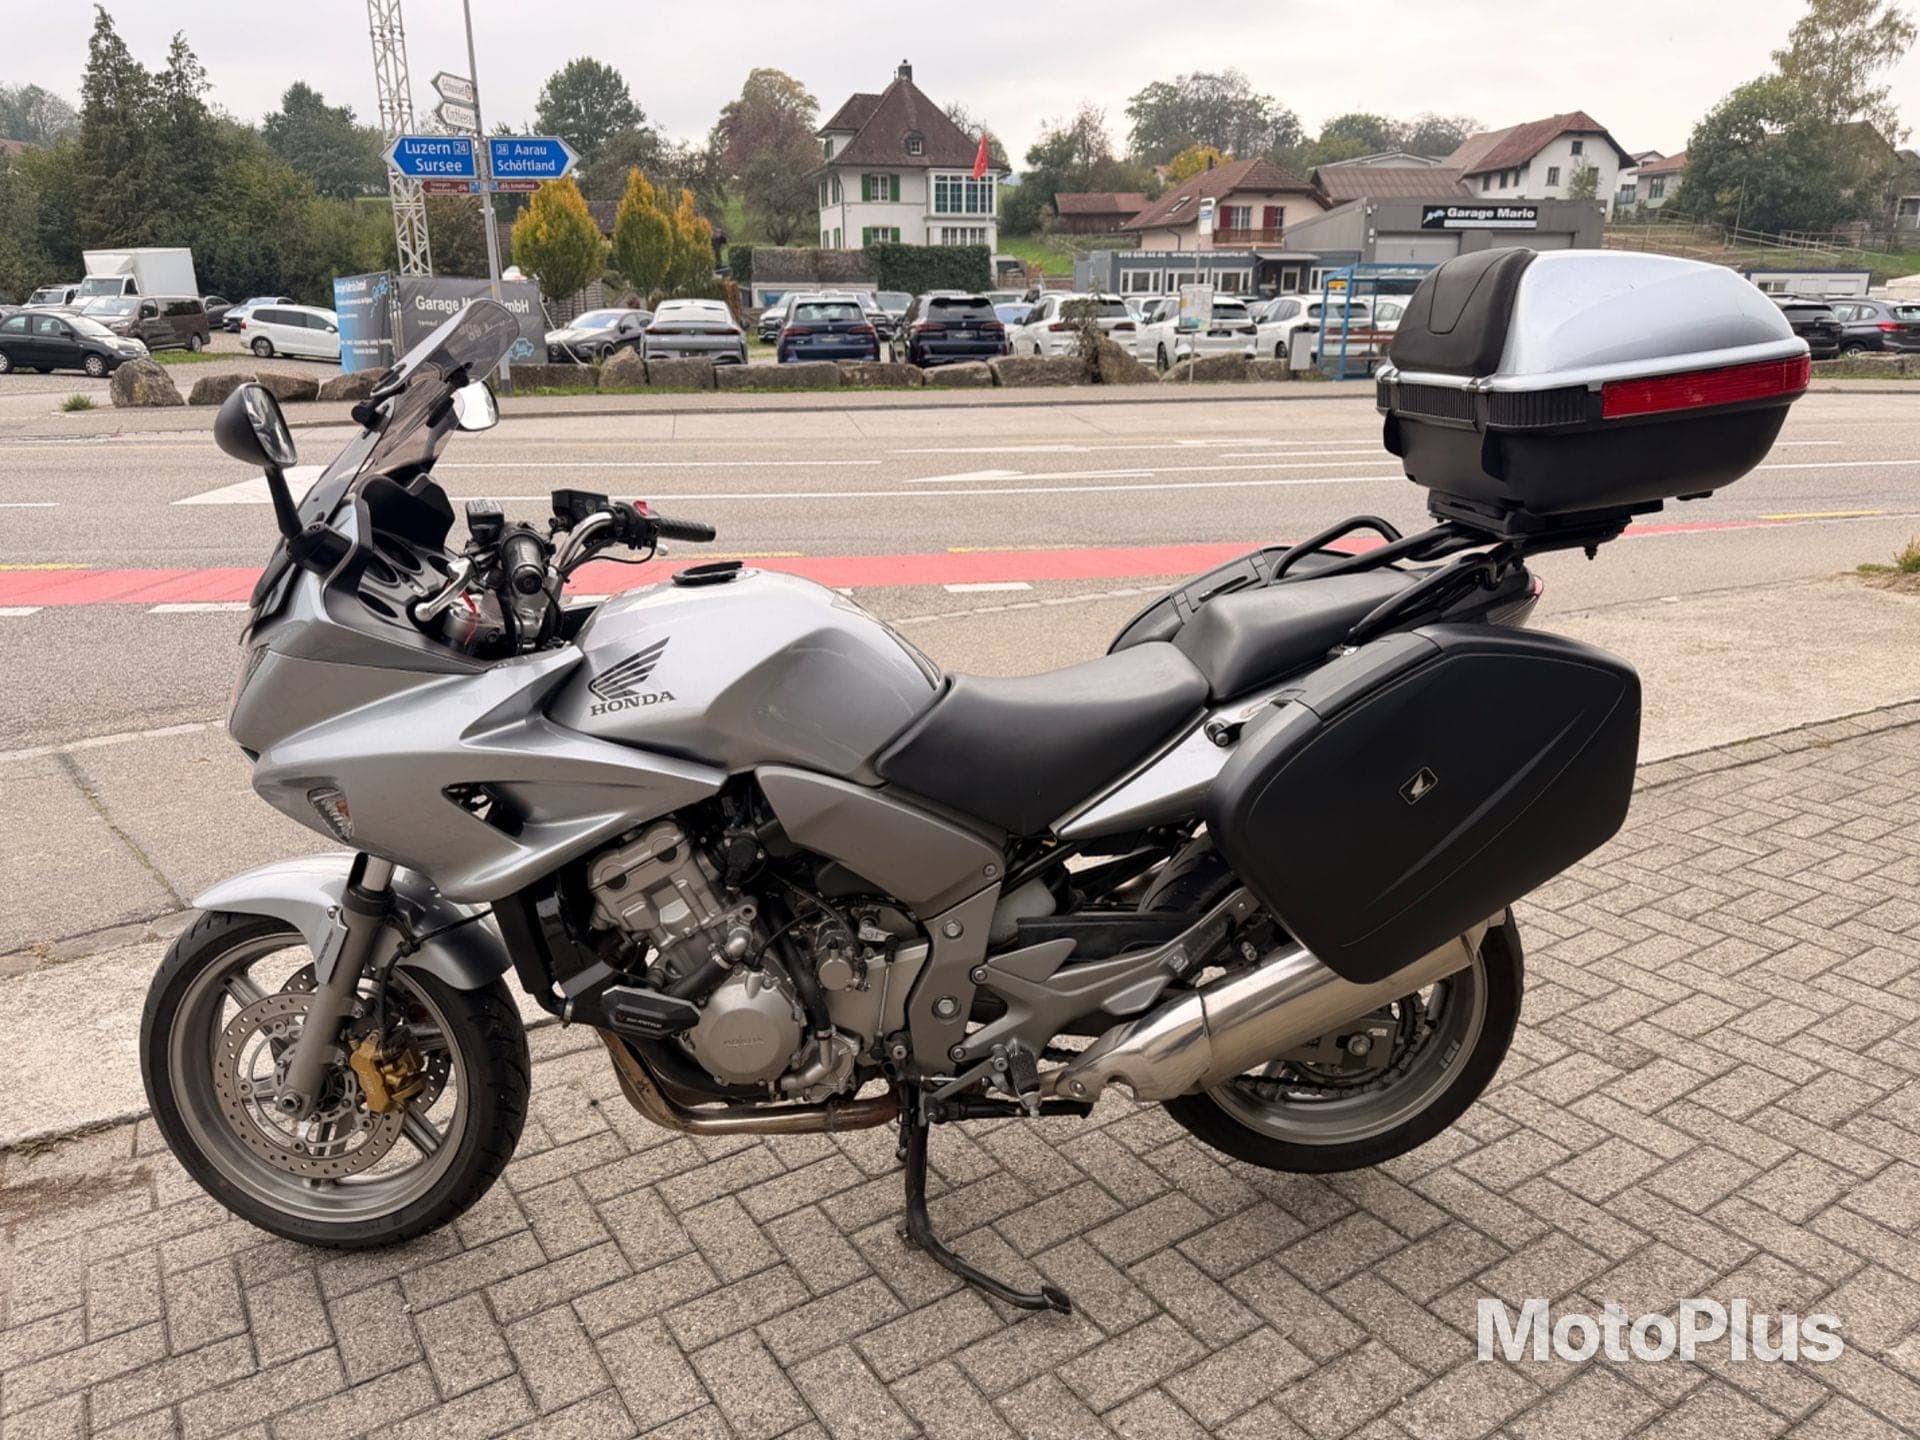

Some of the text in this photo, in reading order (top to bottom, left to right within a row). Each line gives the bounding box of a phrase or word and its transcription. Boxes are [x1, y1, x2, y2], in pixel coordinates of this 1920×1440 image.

[404, 141, 451, 155] Luzern
[514, 144, 547, 156] Aarau
[415, 158, 463, 172] Sursee
[497, 159, 555, 171] Schöftland
[1447, 207, 1535, 220] Garage Mario
[415, 295, 460, 315] Garage
[499, 299, 530, 313] mbH
[590, 690, 677, 717] HONDA
